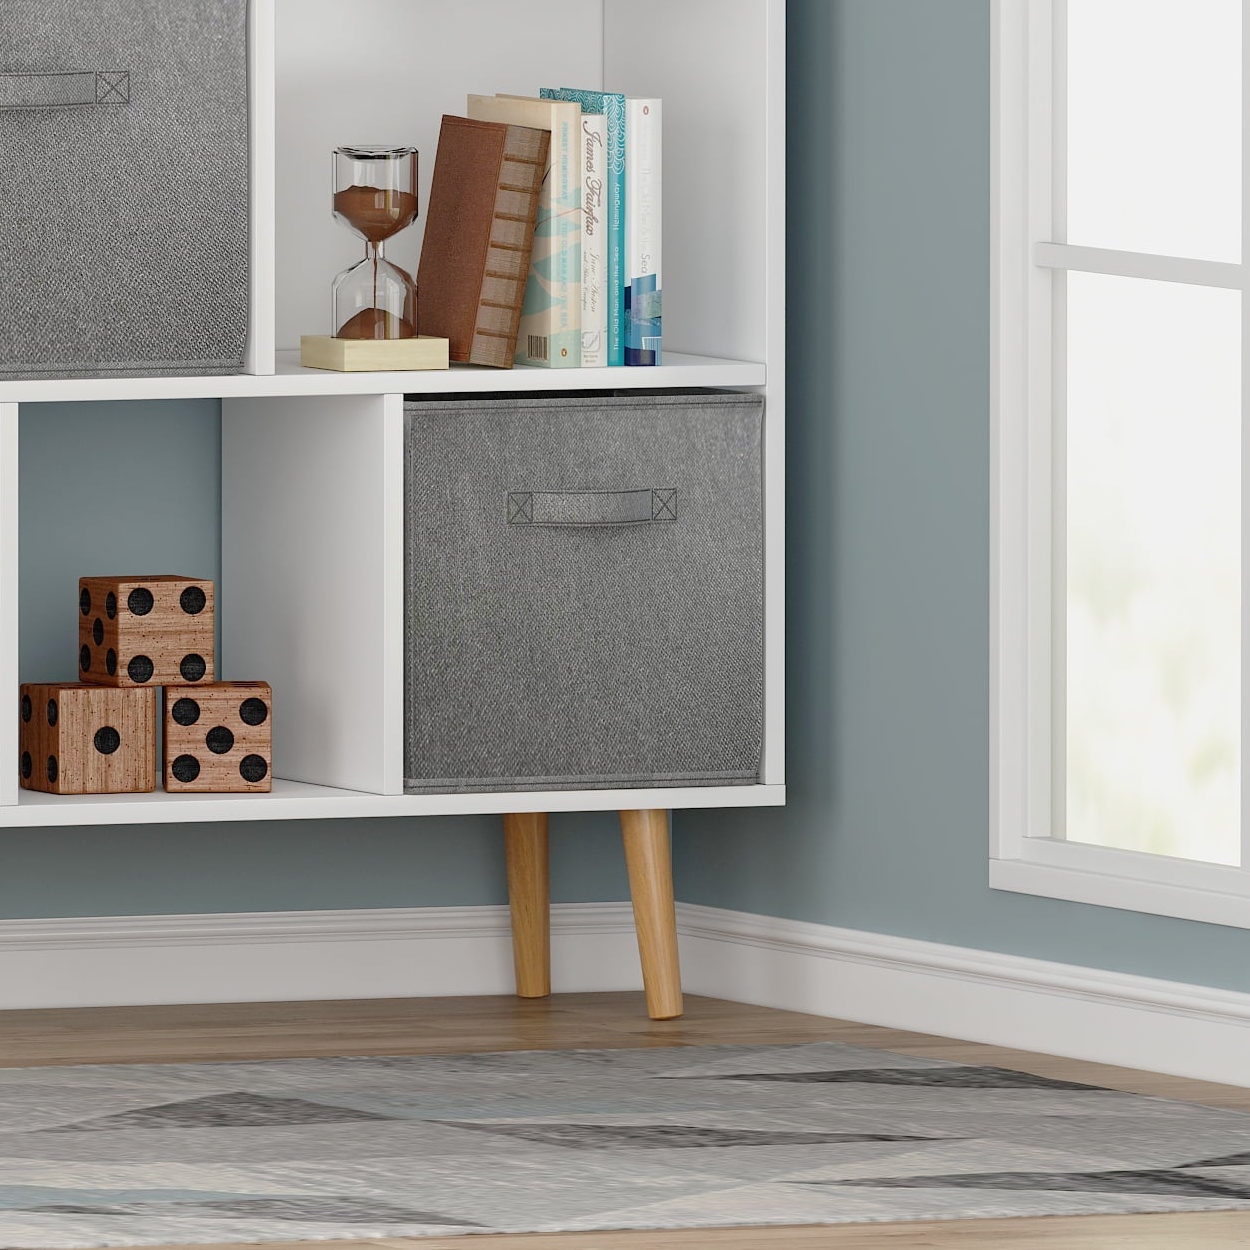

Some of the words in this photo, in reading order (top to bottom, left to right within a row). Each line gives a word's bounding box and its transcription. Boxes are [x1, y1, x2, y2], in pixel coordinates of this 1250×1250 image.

[583, 120, 603, 173] James
[586, 176, 603, 236] Fairfax
[613, 182, 621, 230] Hemingway
[641, 253, 651, 274] Sea
